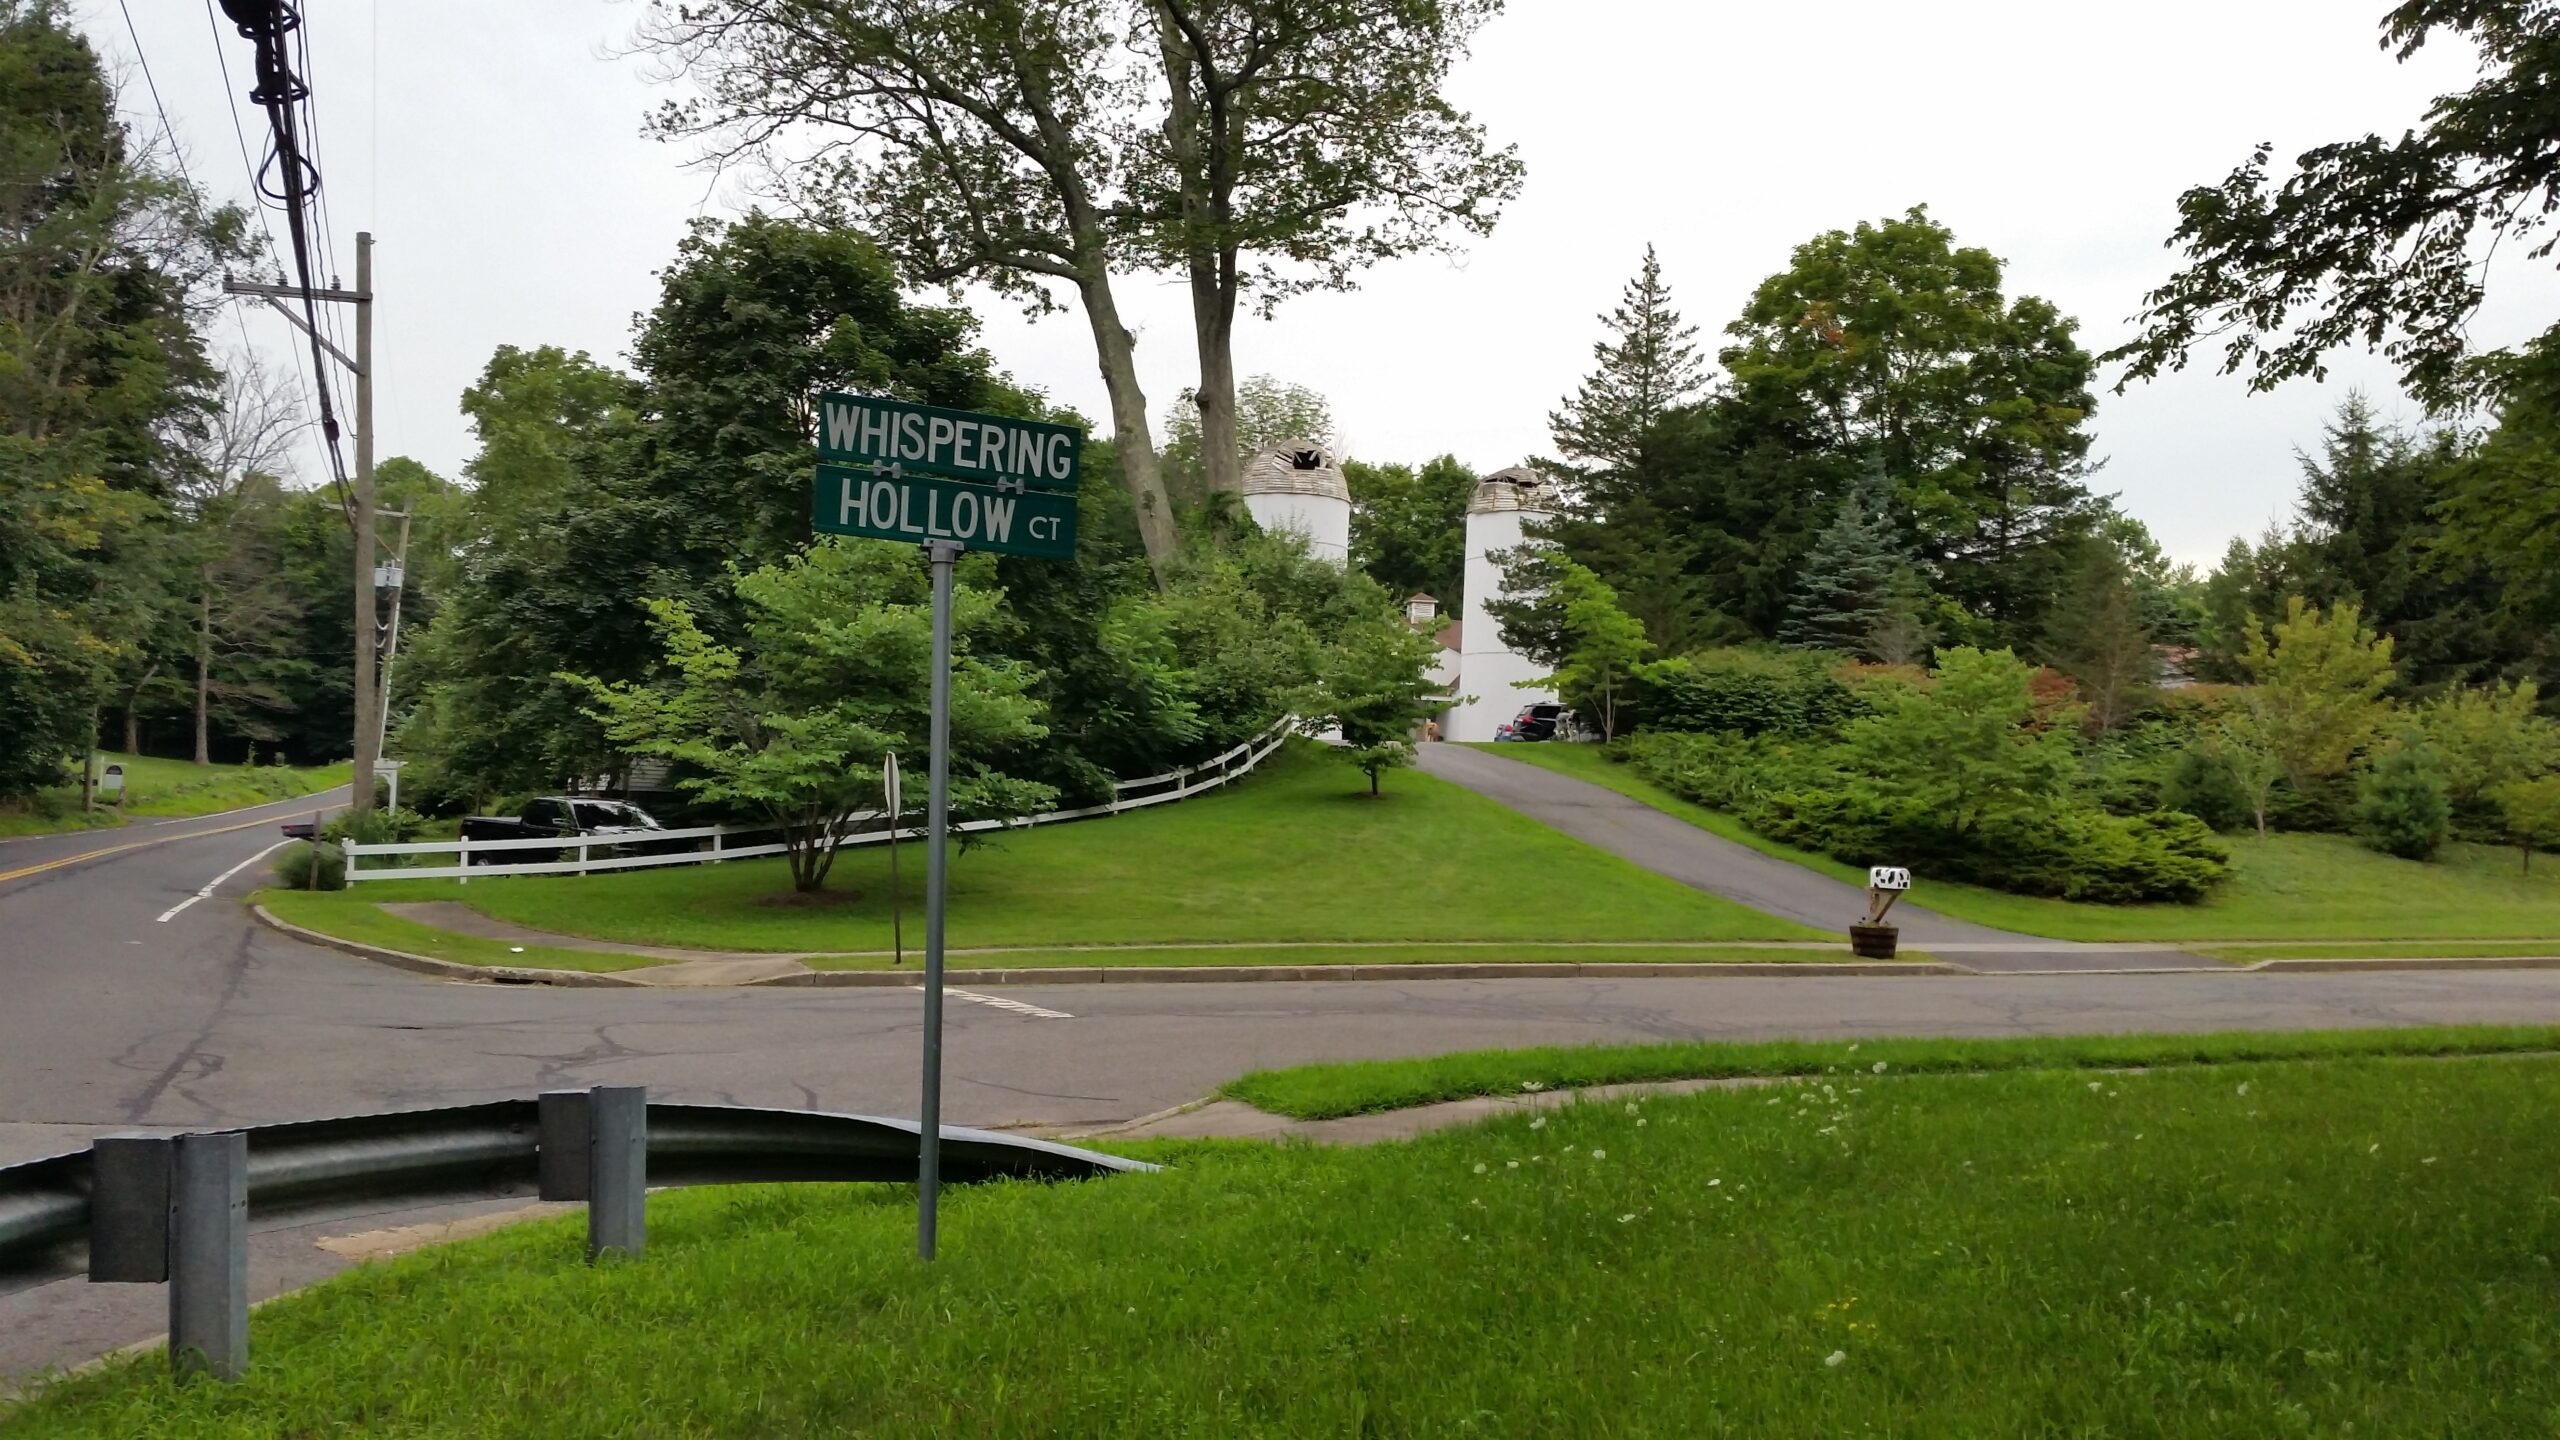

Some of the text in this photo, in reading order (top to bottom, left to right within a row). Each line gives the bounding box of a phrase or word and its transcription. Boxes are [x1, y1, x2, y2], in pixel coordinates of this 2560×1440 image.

[825, 402, 1071, 480] WHISPERING
[840, 478, 1061, 543] HOLLOW CT
